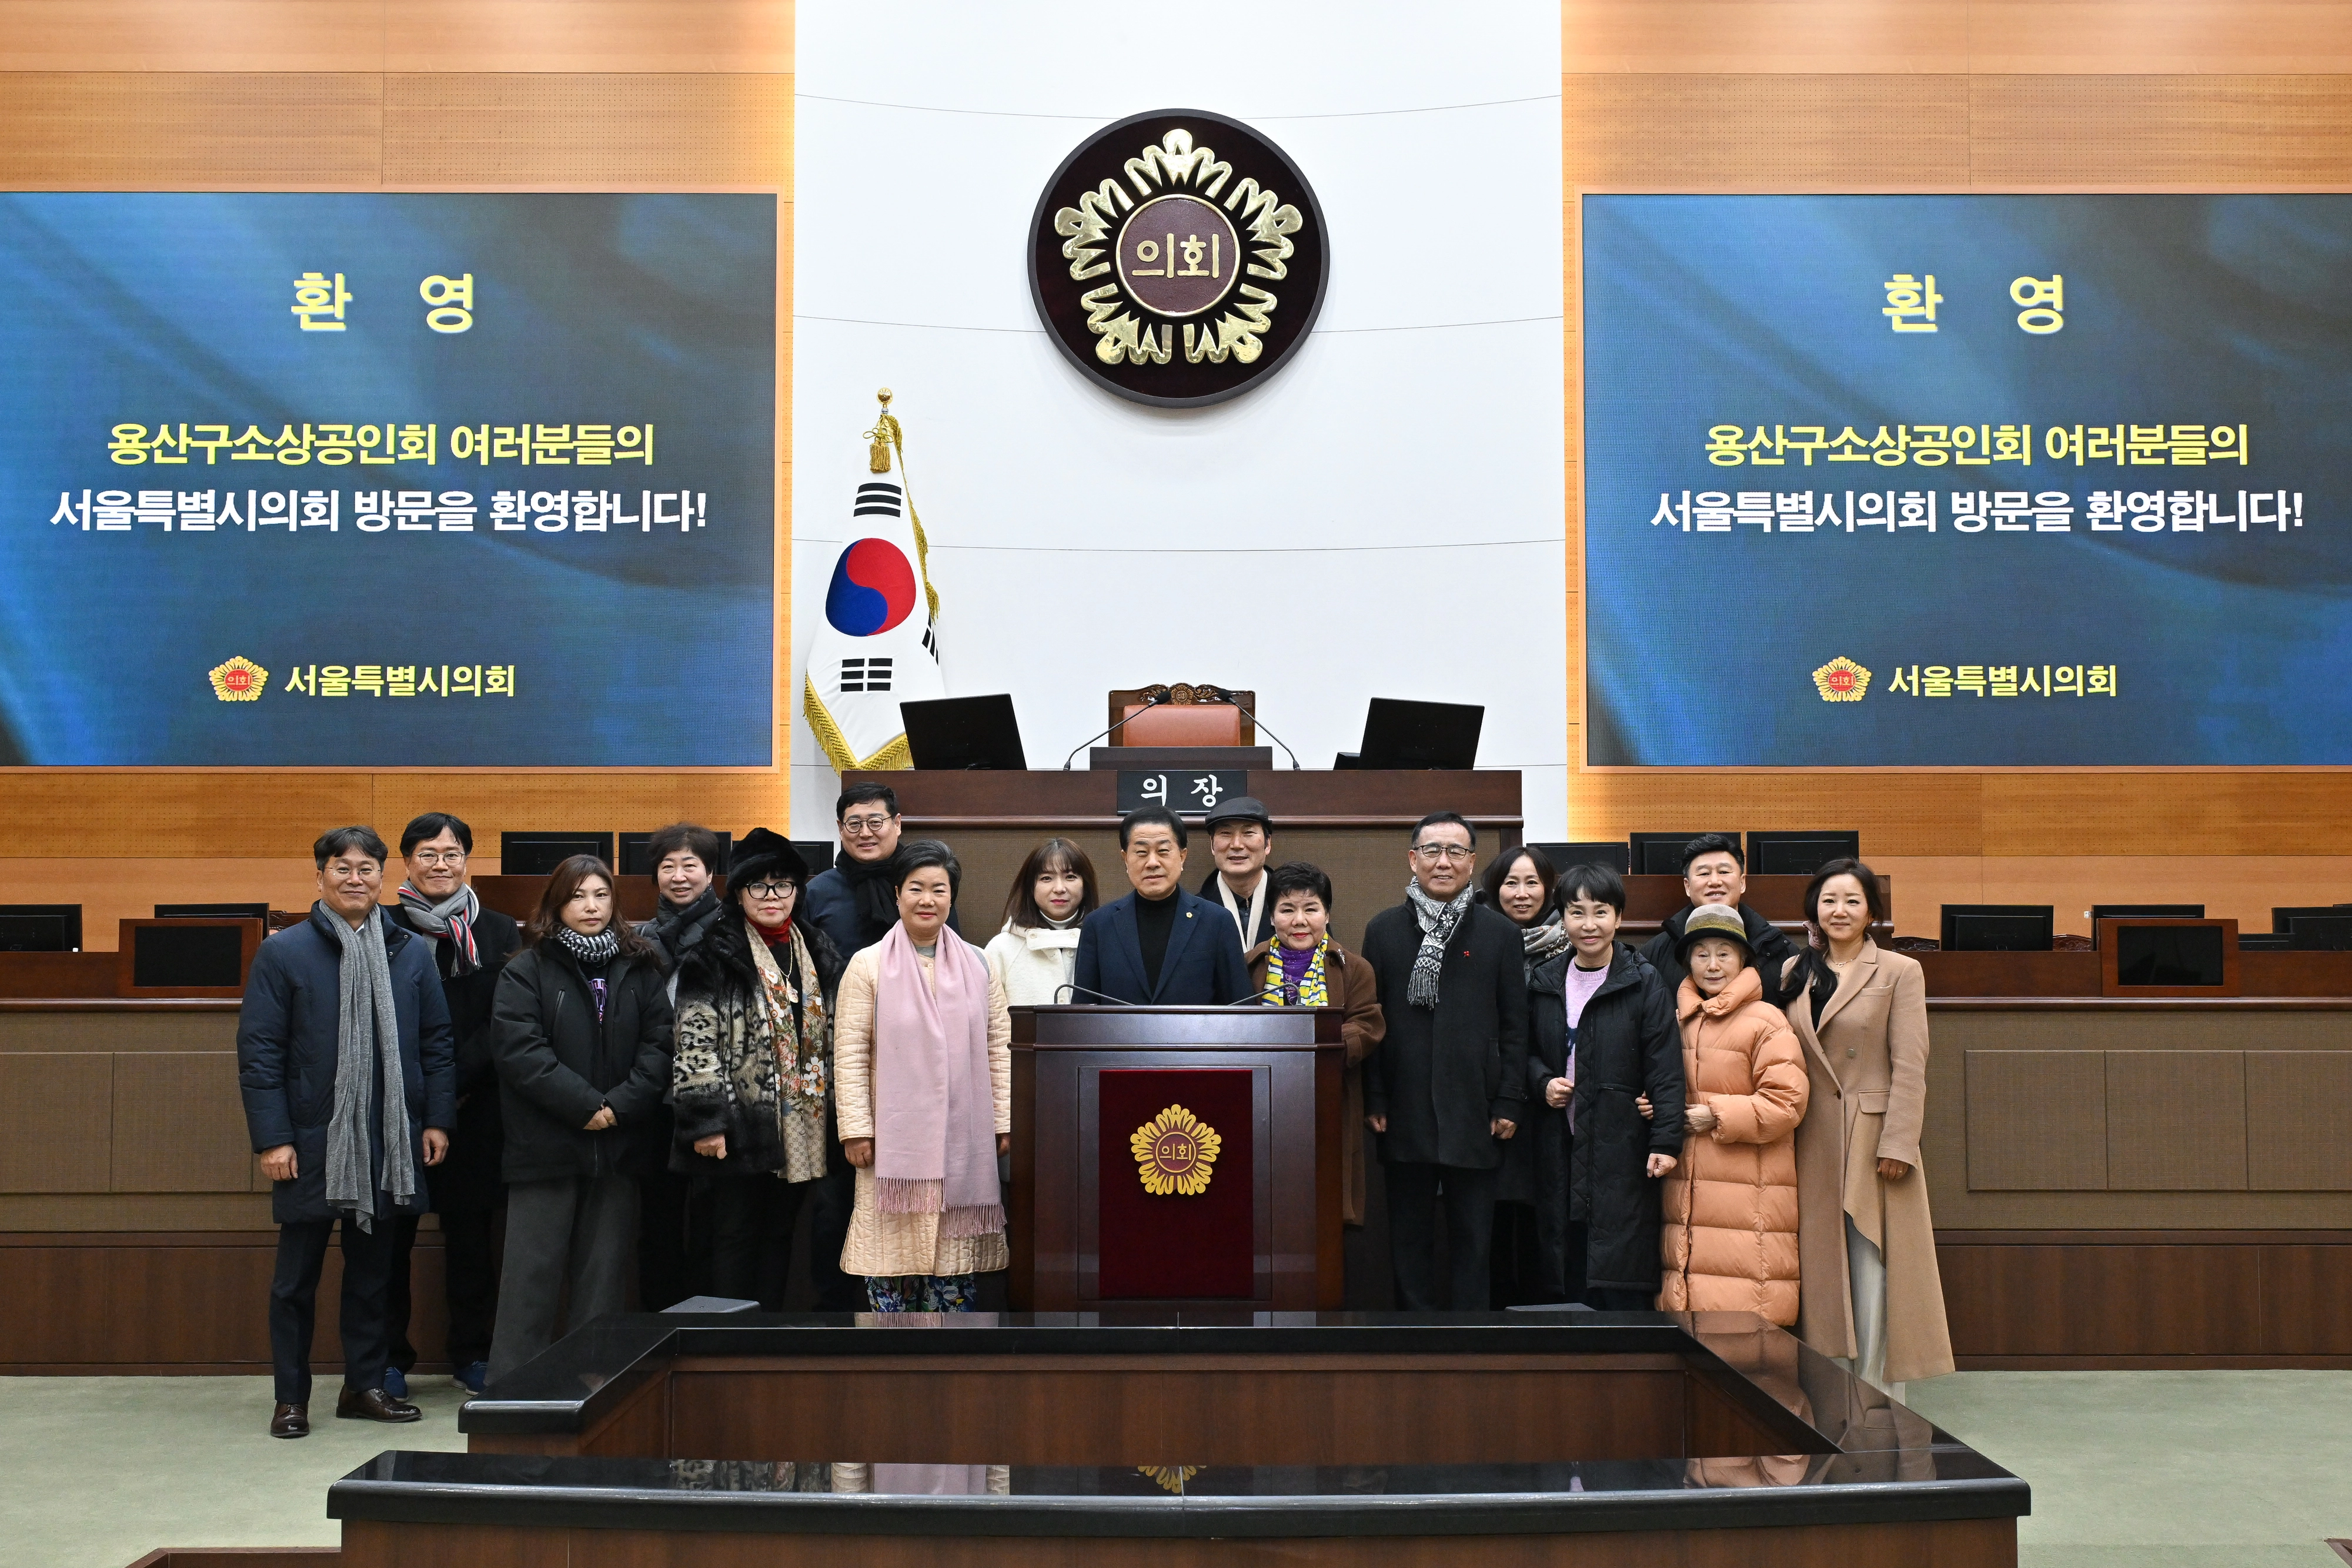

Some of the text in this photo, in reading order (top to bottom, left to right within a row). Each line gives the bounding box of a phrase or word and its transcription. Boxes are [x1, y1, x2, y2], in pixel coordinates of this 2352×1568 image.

[1132, 233, 1220, 279] 의회
[290, 272, 474, 333] 환 영
[1882, 274, 2064, 335] 환 영
[107, 423, 653, 466] 용산구소상공인회 여러분들의
[1704, 424, 2248, 466] 용산구소상공인회 여러분들의
[50, 489, 706, 532] 서울특별시의회 방문을 환영합니다!
[1651, 490, 2303, 533] 서울특별시의회 방문을 환영합니다!
[227, 676, 250, 686] 의회
[285, 664, 514, 697] 서울특별시의회
[1830, 676, 1854, 686] 의회
[1888, 665, 2116, 697] 서울특별시의회
[1141, 774, 1223, 807] 의 장
[1160, 1144, 1191, 1161] 의회
